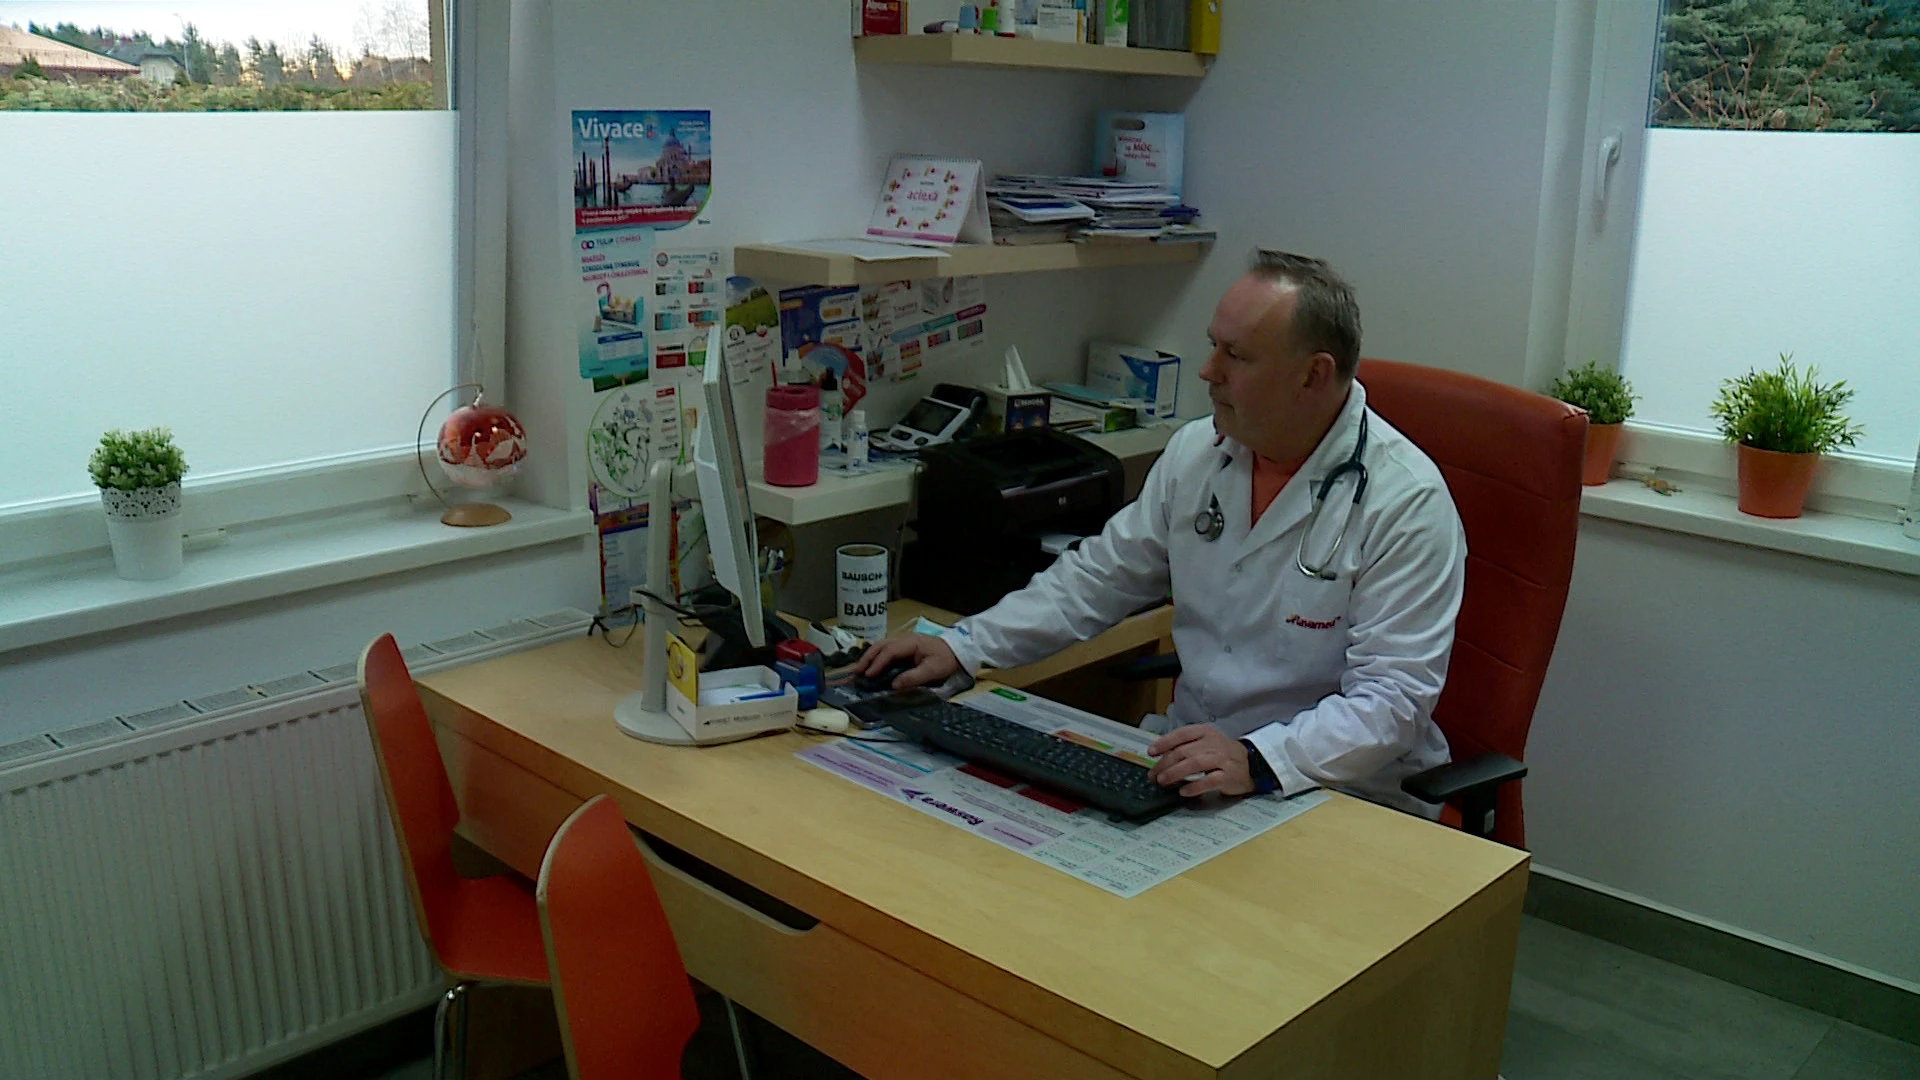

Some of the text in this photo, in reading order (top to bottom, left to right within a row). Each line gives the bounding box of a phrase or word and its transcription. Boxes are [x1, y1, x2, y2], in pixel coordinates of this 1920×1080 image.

[578, 117, 644, 139] Vivace
[842, 571, 883, 582] BAUSCH
[843, 601, 887, 617] BAUS
